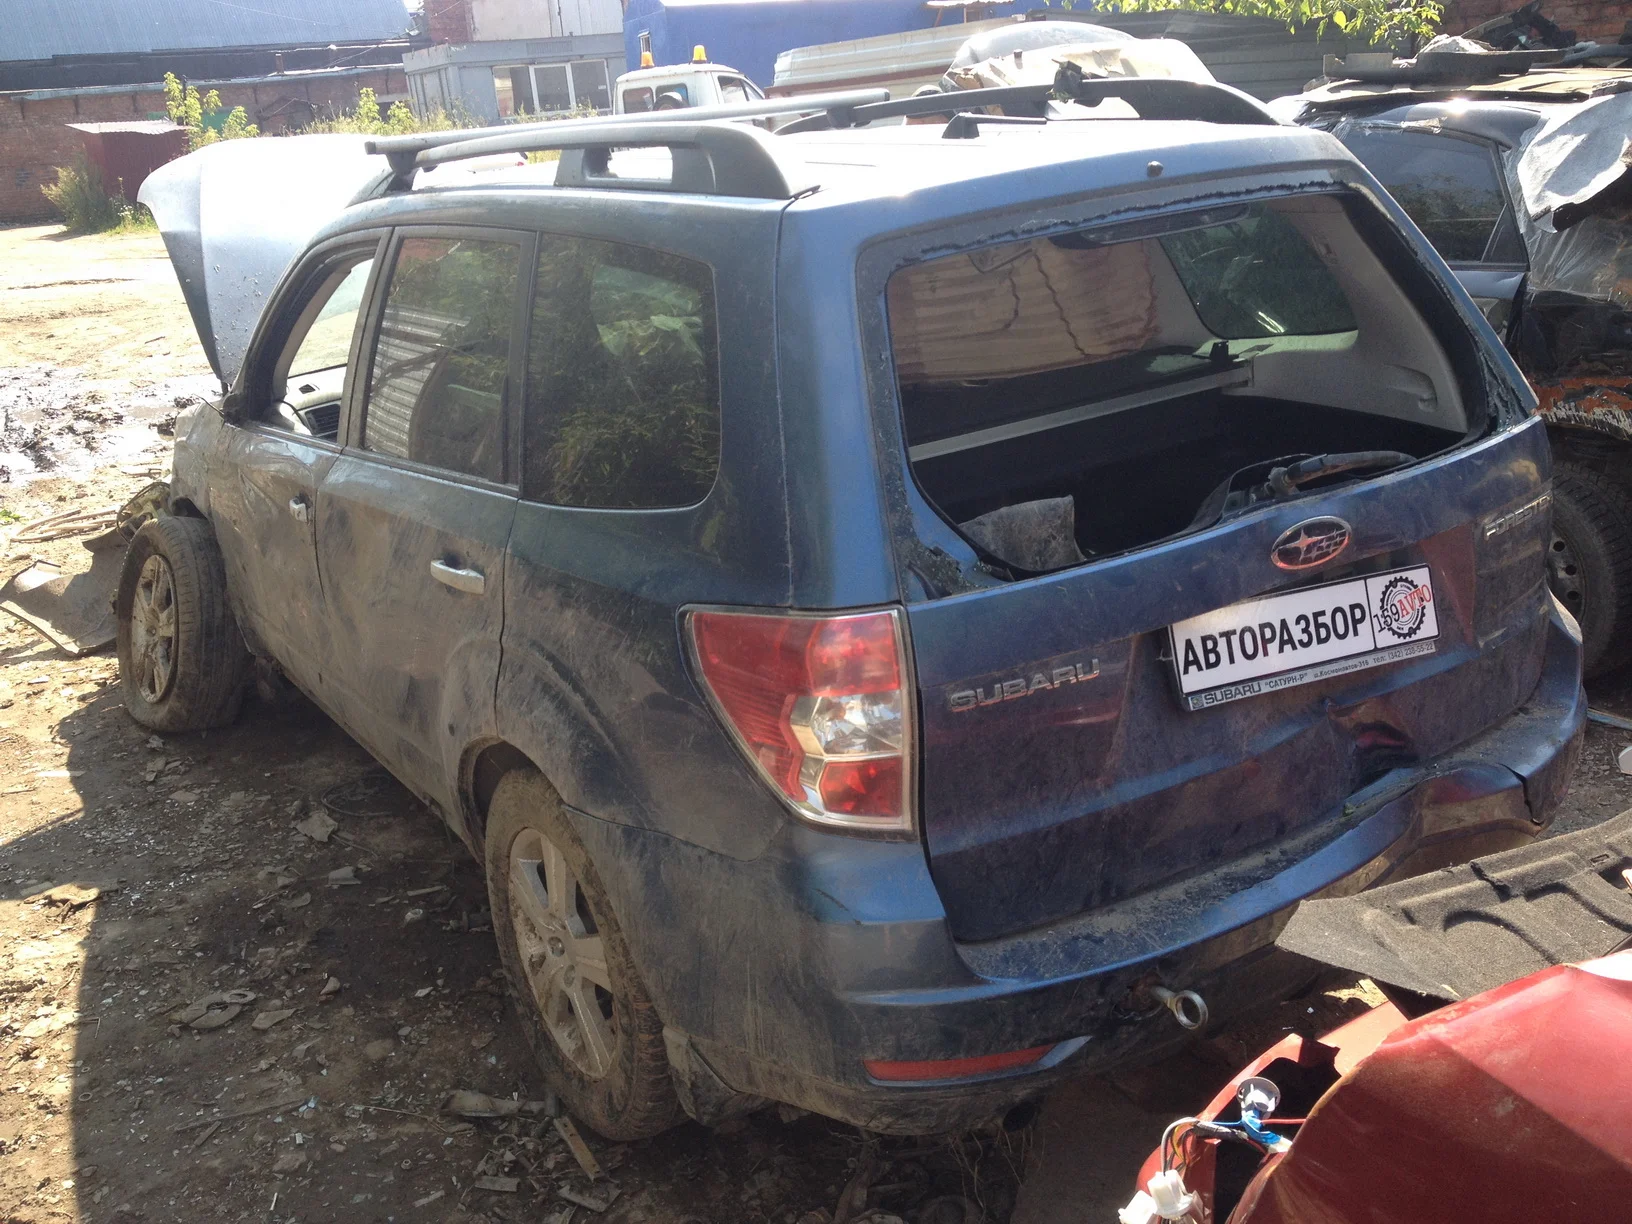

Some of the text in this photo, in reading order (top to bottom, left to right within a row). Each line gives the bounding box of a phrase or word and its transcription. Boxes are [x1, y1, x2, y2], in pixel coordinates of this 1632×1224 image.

[1182, 602, 1367, 676] АВТОРАЗБОР
[950, 658, 1100, 713] SUBARU
[1204, 682, 1262, 705] SUBARU
